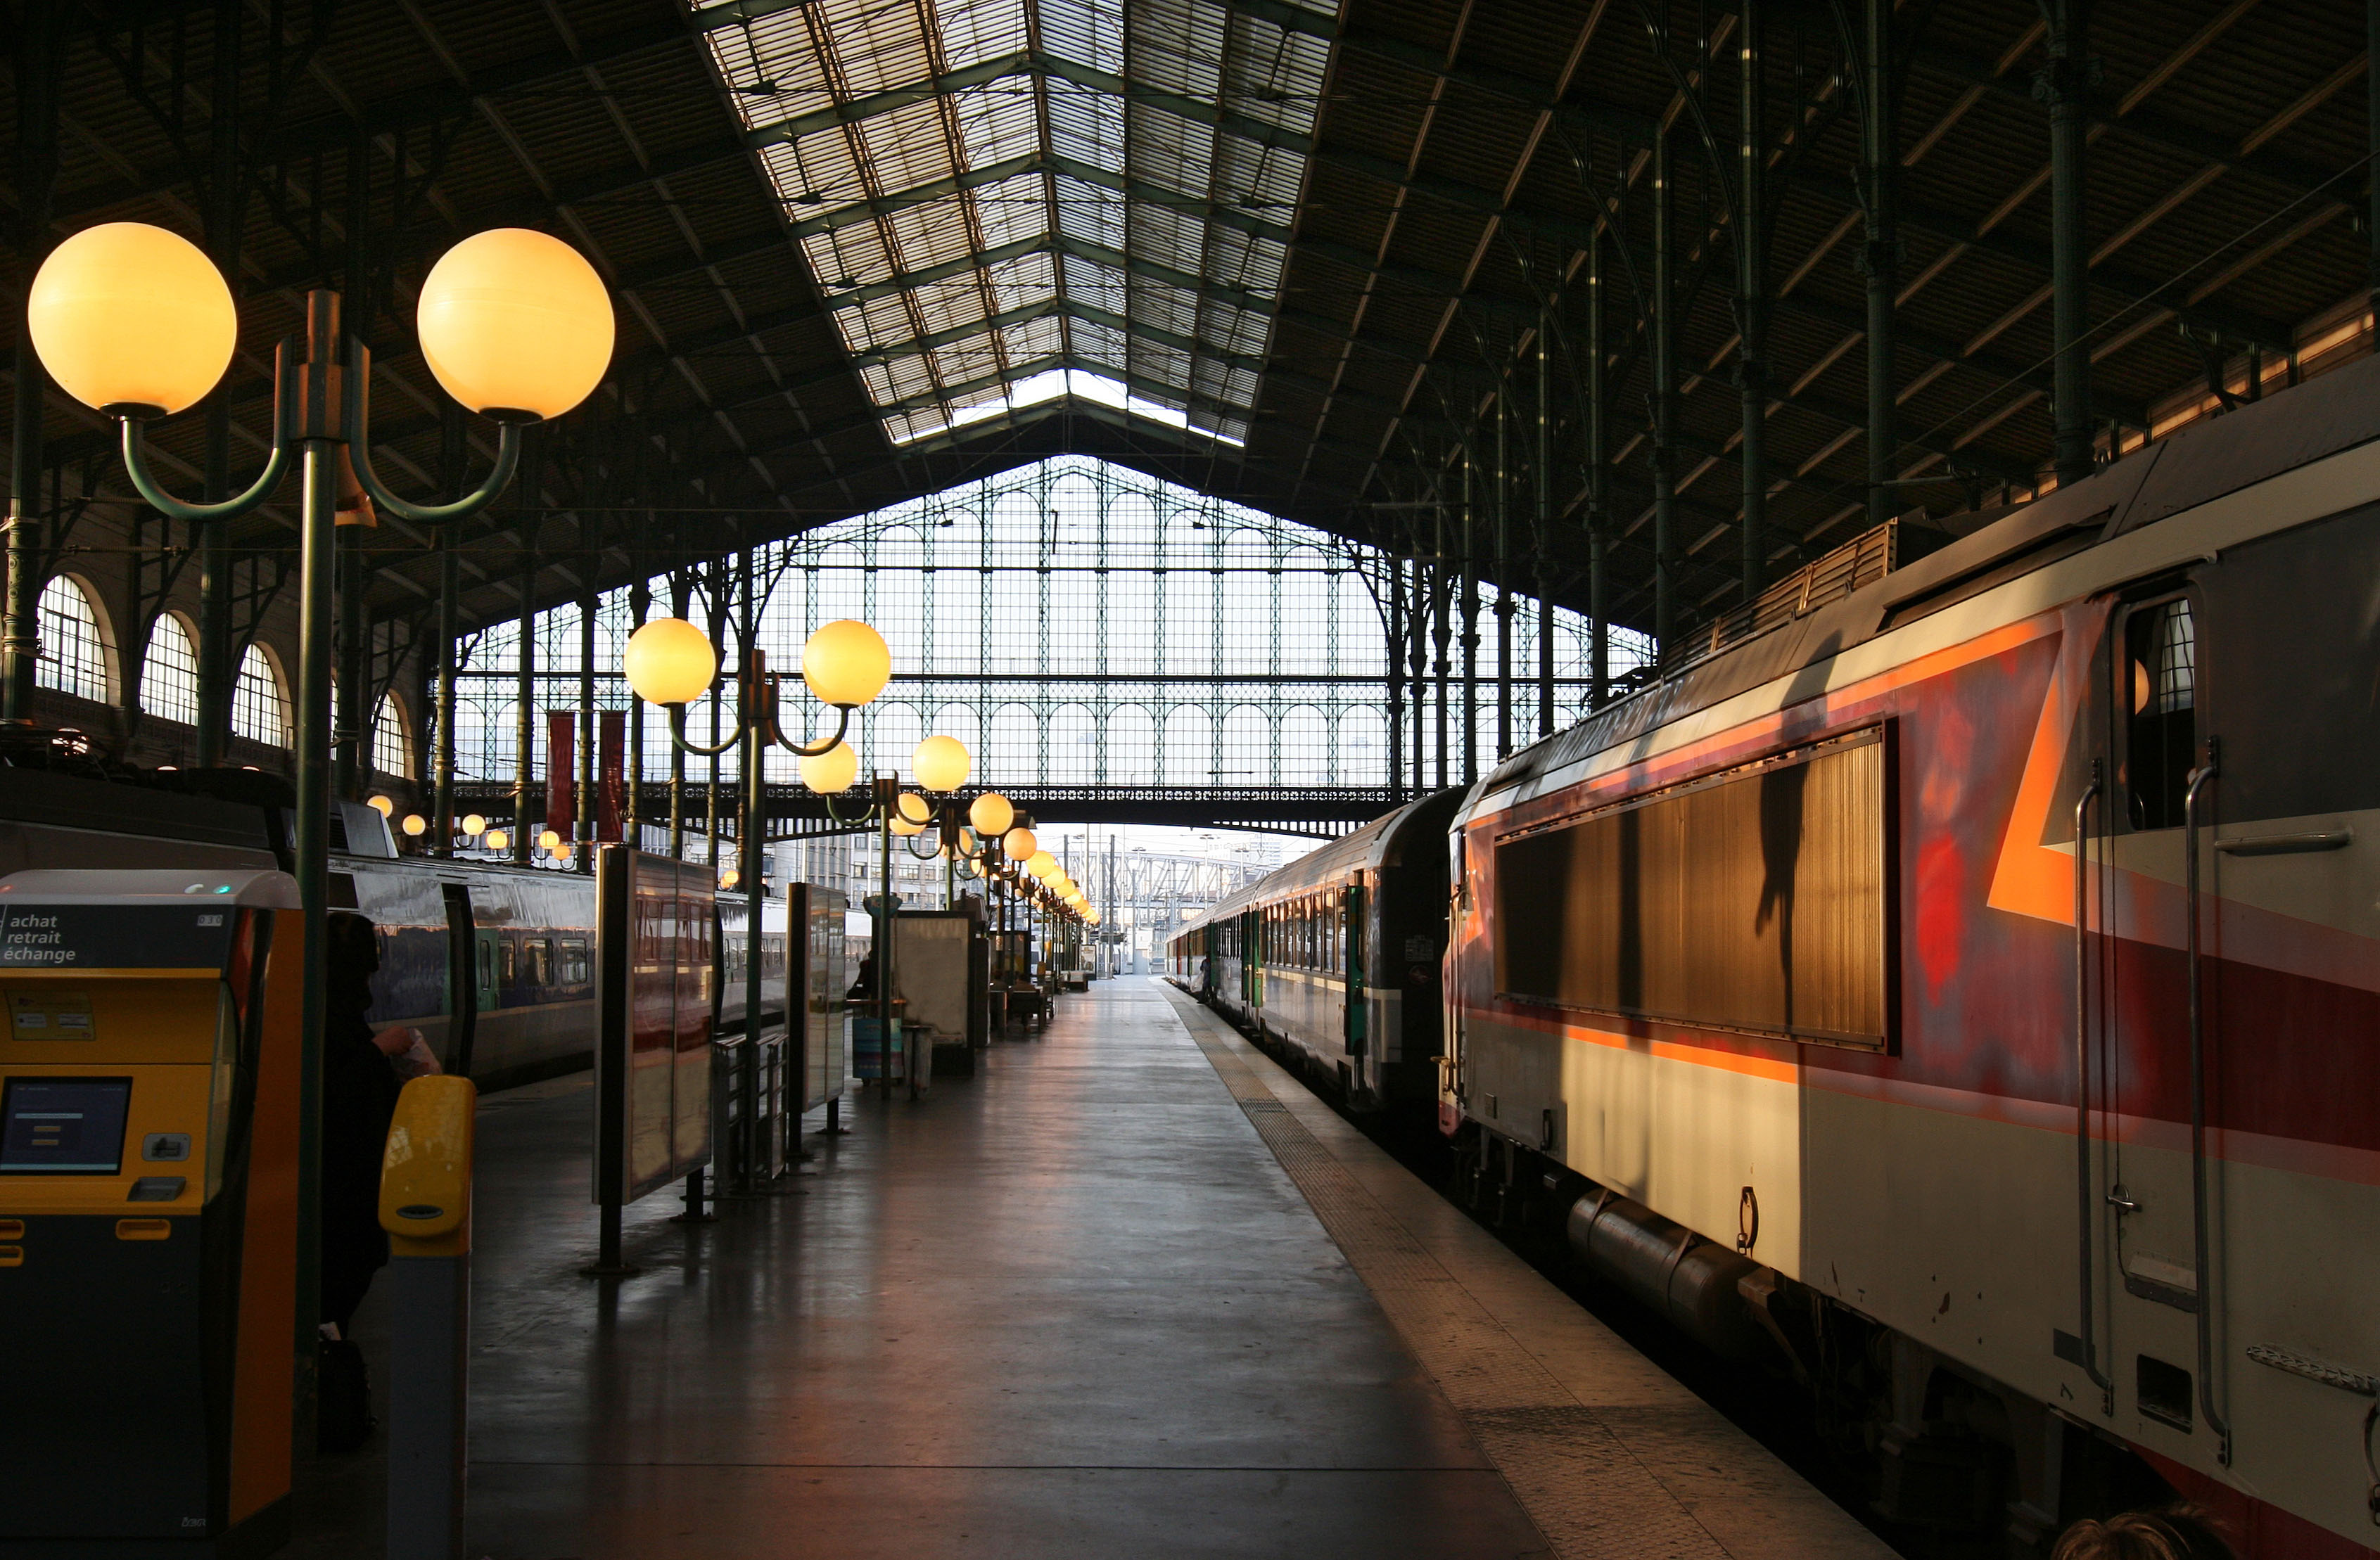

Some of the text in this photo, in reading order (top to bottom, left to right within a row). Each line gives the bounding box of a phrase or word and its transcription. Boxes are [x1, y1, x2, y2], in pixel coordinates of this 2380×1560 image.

[10, 914, 58, 928] achat
[6, 931, 61, 944] retrait
[4, 947, 76, 964] échange
